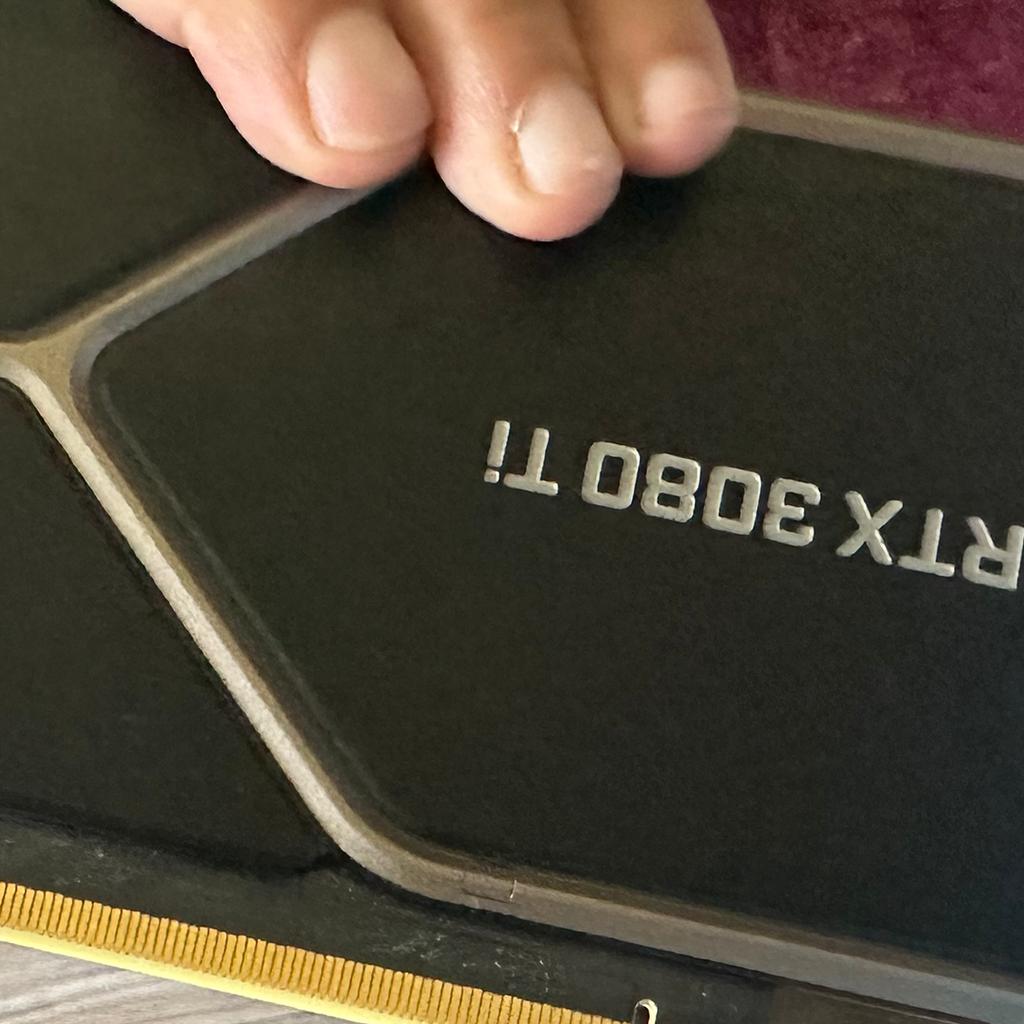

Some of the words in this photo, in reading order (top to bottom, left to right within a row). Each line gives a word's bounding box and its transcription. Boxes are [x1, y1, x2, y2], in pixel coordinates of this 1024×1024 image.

[483, 420, 559, 497] Ti
[581, 440, 822, 547] 3080
[835, 490, 1024, 591] RTX
